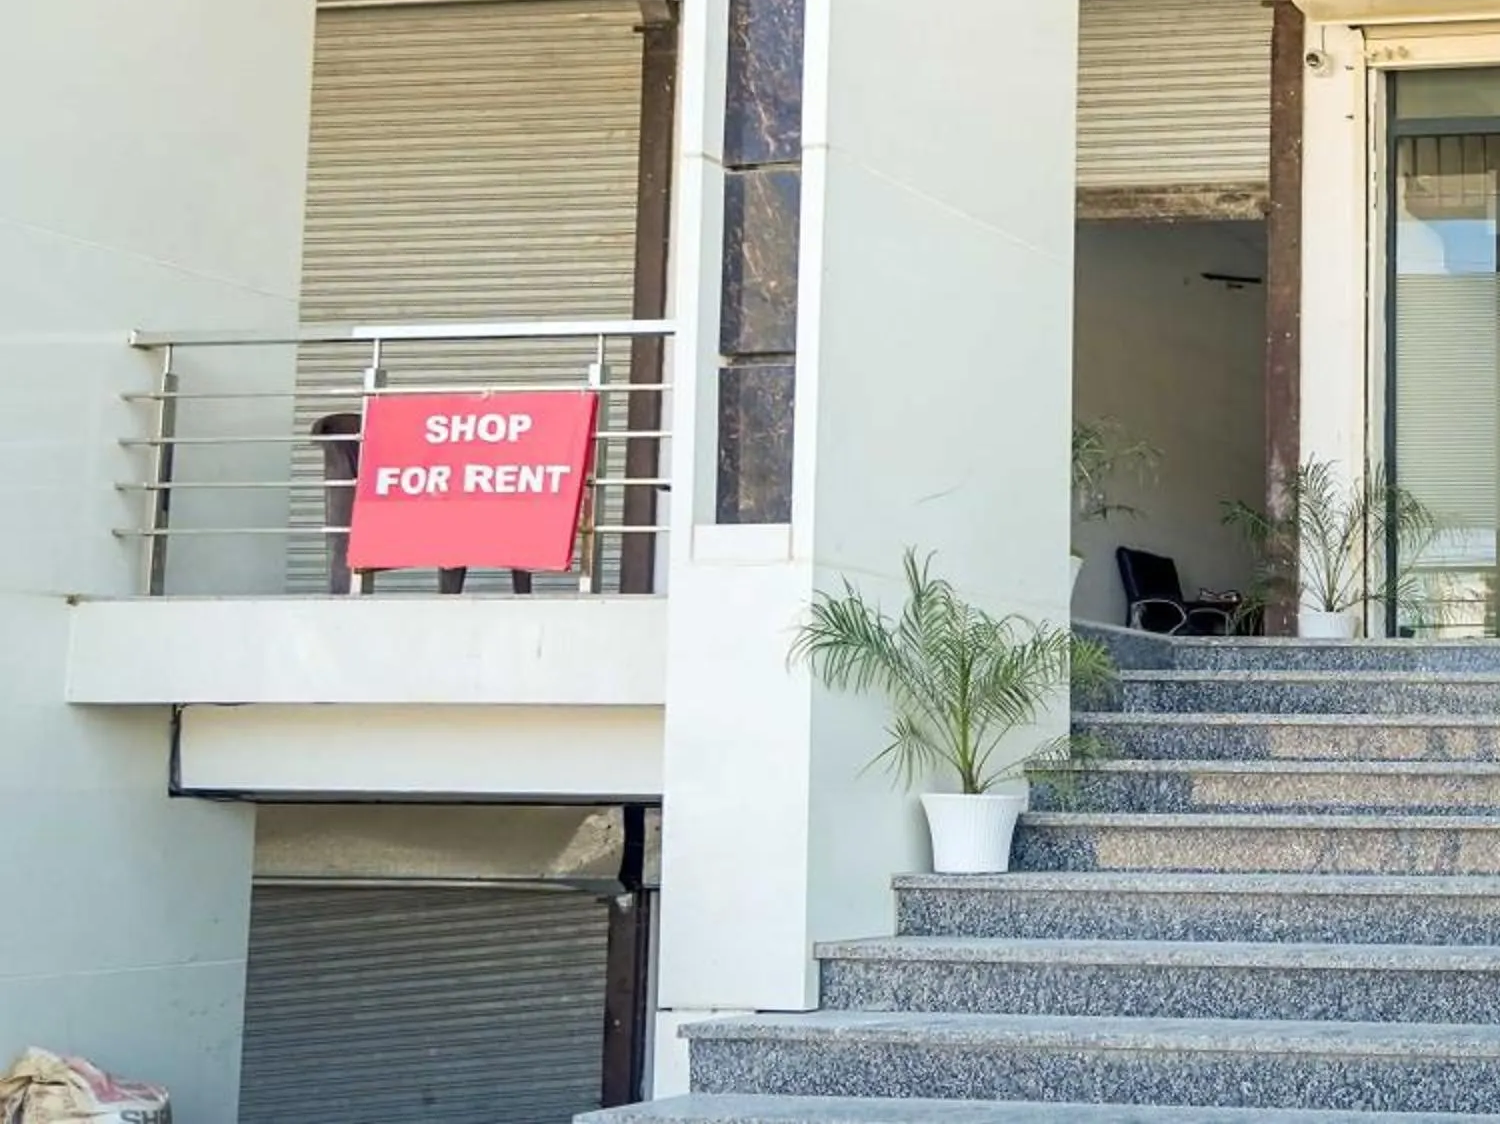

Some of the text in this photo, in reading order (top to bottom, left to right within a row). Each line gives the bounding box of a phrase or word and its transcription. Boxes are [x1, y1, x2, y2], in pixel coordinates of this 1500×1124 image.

[425, 414, 532, 443] SHOP
[375, 464, 571, 495] FOR RENT
